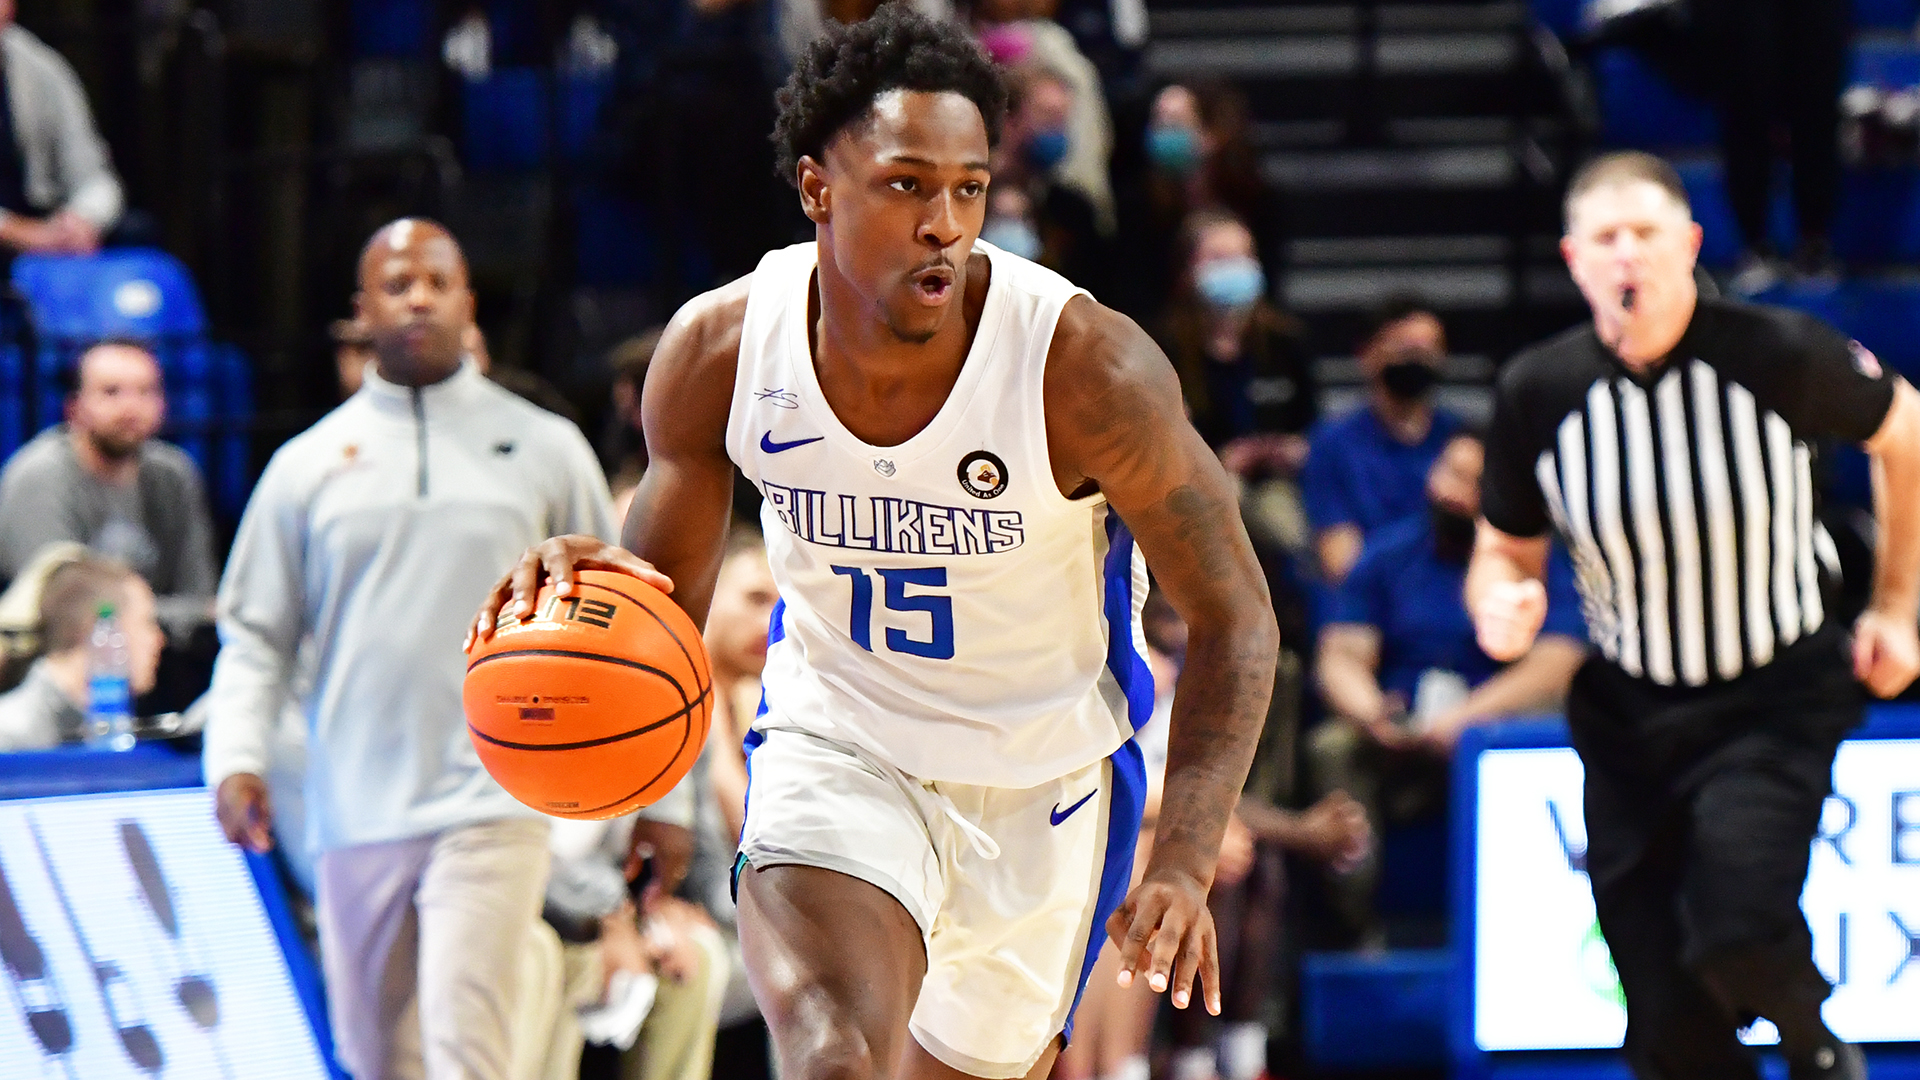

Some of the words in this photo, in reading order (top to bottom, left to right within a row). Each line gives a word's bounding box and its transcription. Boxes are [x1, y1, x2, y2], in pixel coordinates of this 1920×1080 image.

[762, 479, 1025, 555] BILLIKENS
[961, 479, 981, 498] United
[993, 483, 1005, 495] One
[830, 565, 955, 660] 15
